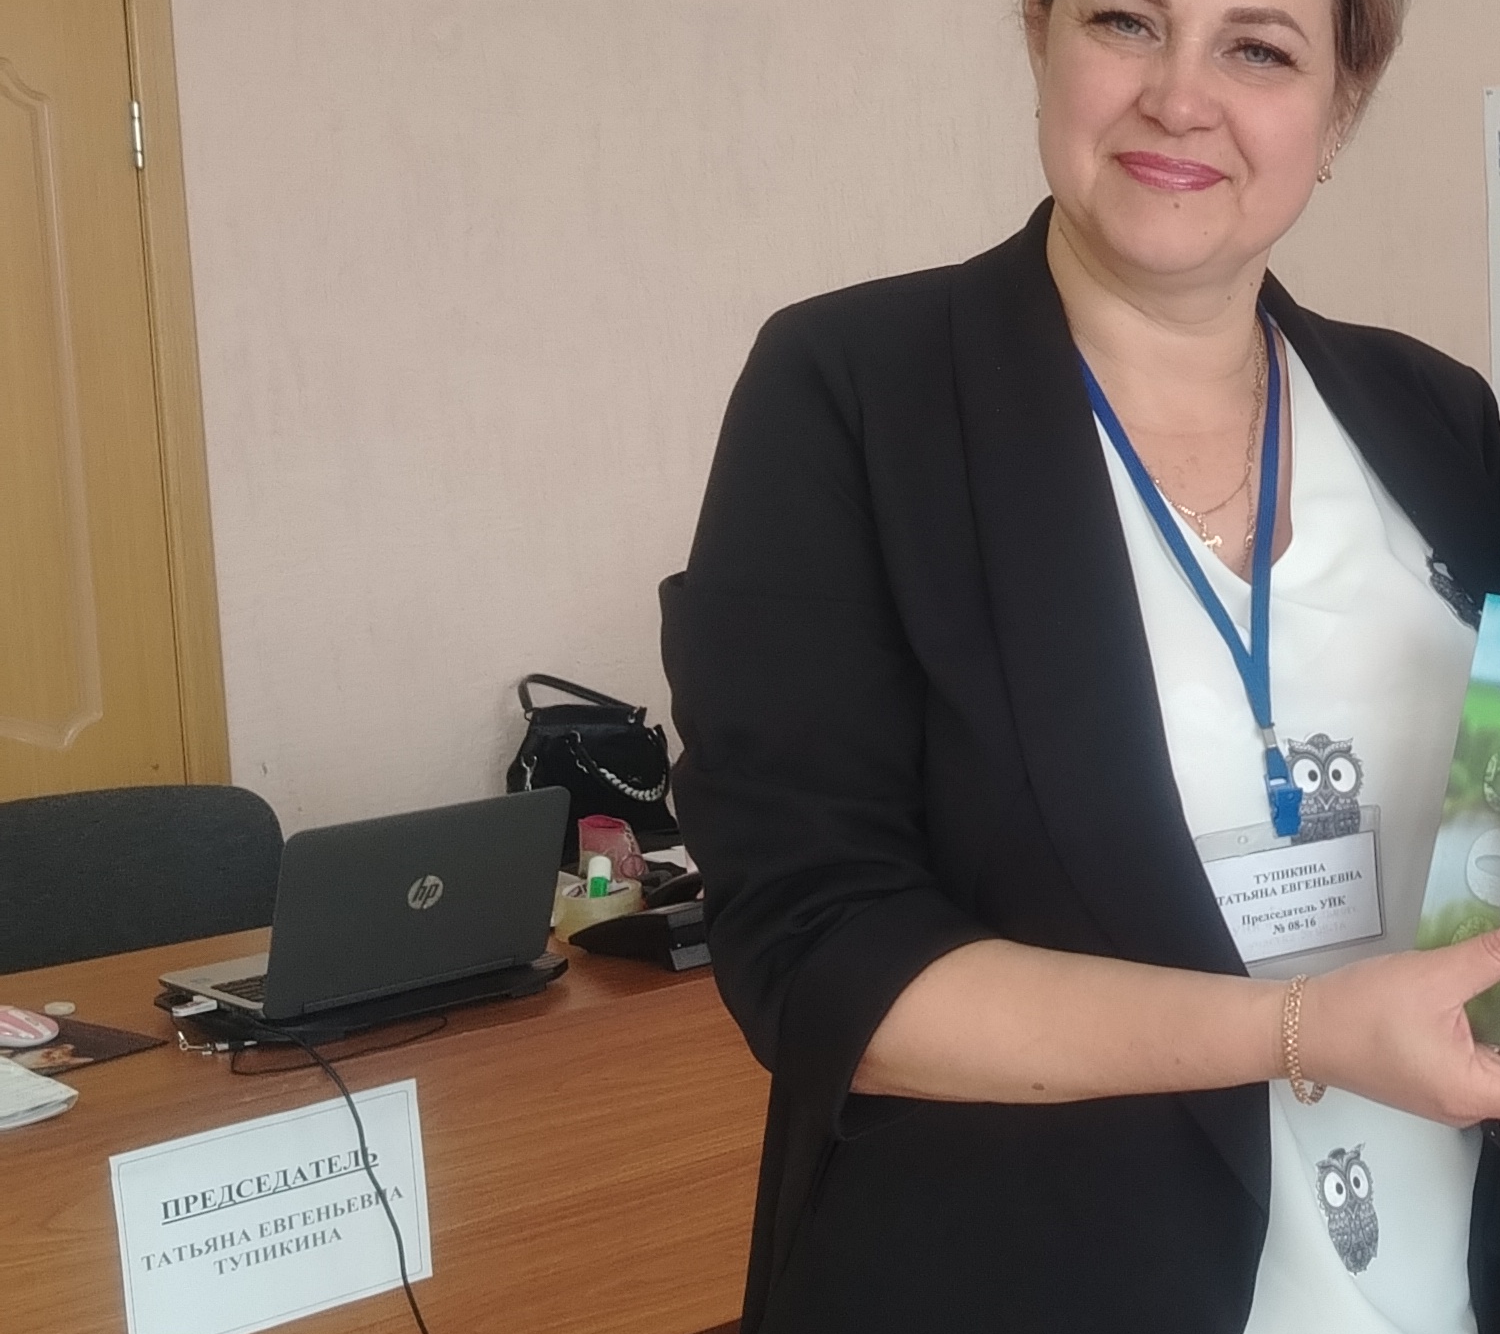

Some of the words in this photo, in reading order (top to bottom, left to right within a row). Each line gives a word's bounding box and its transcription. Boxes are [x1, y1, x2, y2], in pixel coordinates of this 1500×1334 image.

[1216, 885, 1278, 907] ТАТЬЯНА
[1281, 869, 1363, 895] ЕВГЕНЬЕВНА
[1253, 862, 1327, 885] ТУПИКИНА
[411, 875, 440, 909] hp
[1241, 904, 1318, 927] Председатель
[1272, 922, 1286, 935] №
[1287, 916, 1317, 932] 08-16
[161, 1146, 380, 1222] ПРЕДСЕДАТЕЛЬ
[140, 1227, 253, 1272] ТАТЬЯНА
[258, 1185, 405, 1239] ЕВГЕНЬЕВНА
[212, 1226, 343, 1276] ТУПИКИНА
